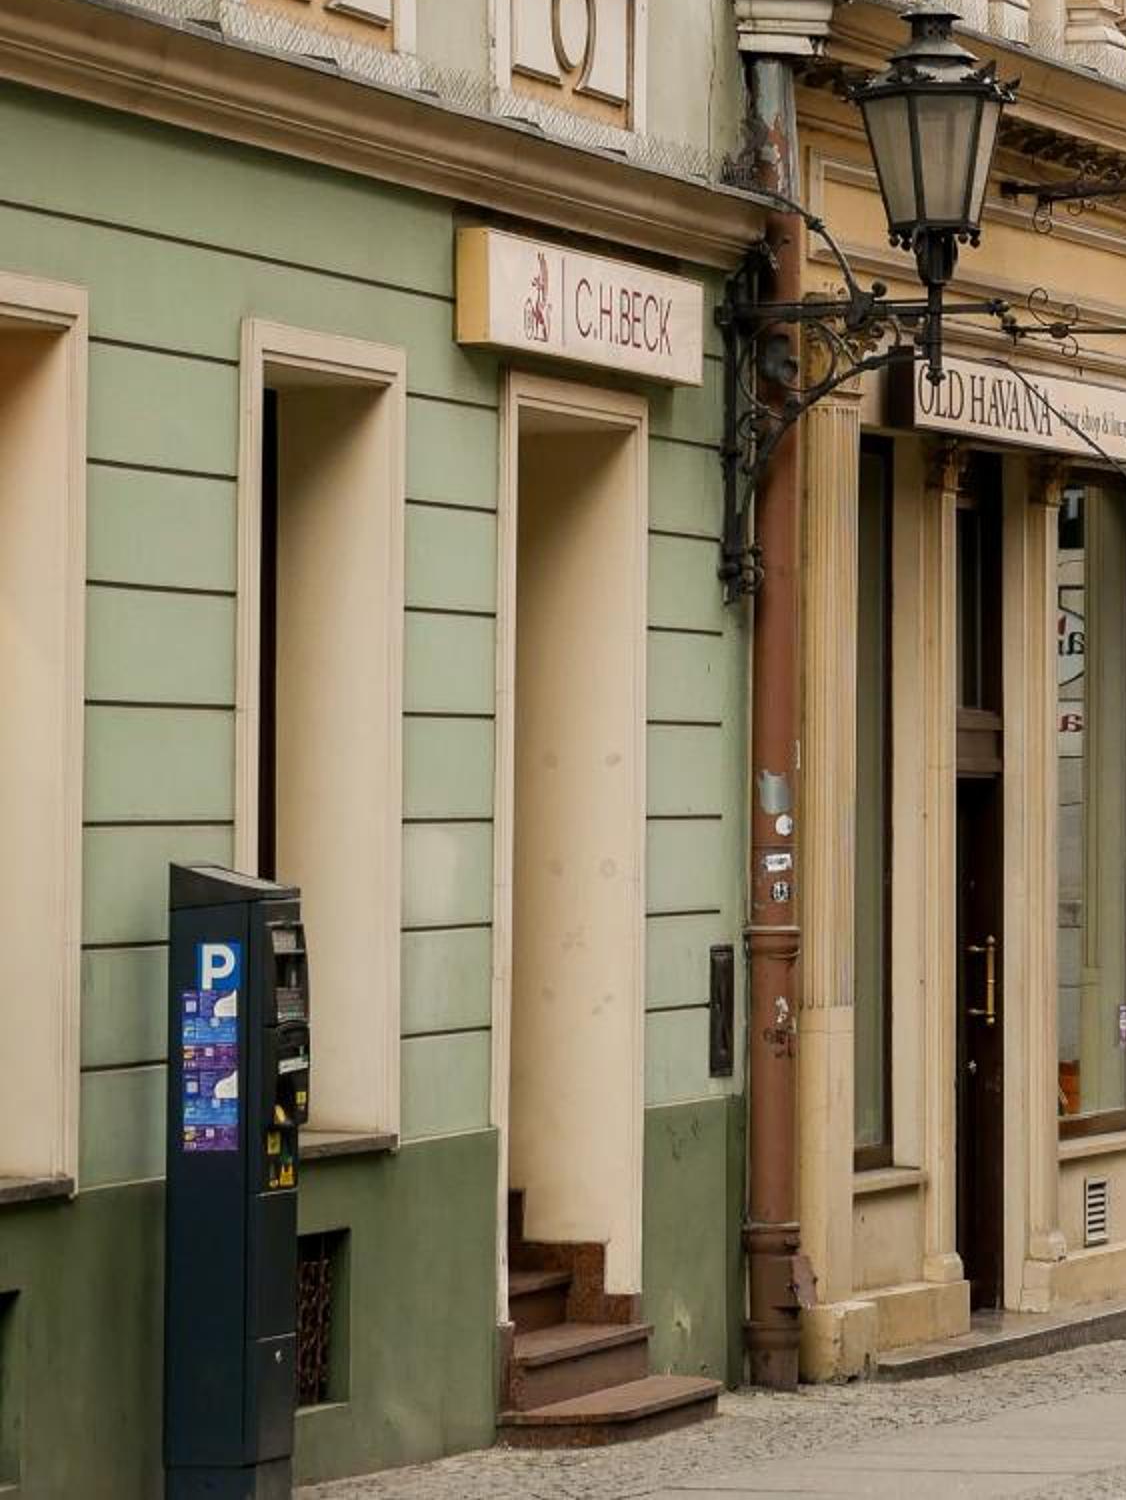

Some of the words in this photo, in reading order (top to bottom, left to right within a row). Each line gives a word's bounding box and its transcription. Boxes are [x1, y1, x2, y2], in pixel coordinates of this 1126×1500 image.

[576, 278, 672, 356] C.H.BECK
[918, 363, 965, 420] OLD
[970, 375, 1052, 436] HAVANA
[202, 944, 235, 990] P
